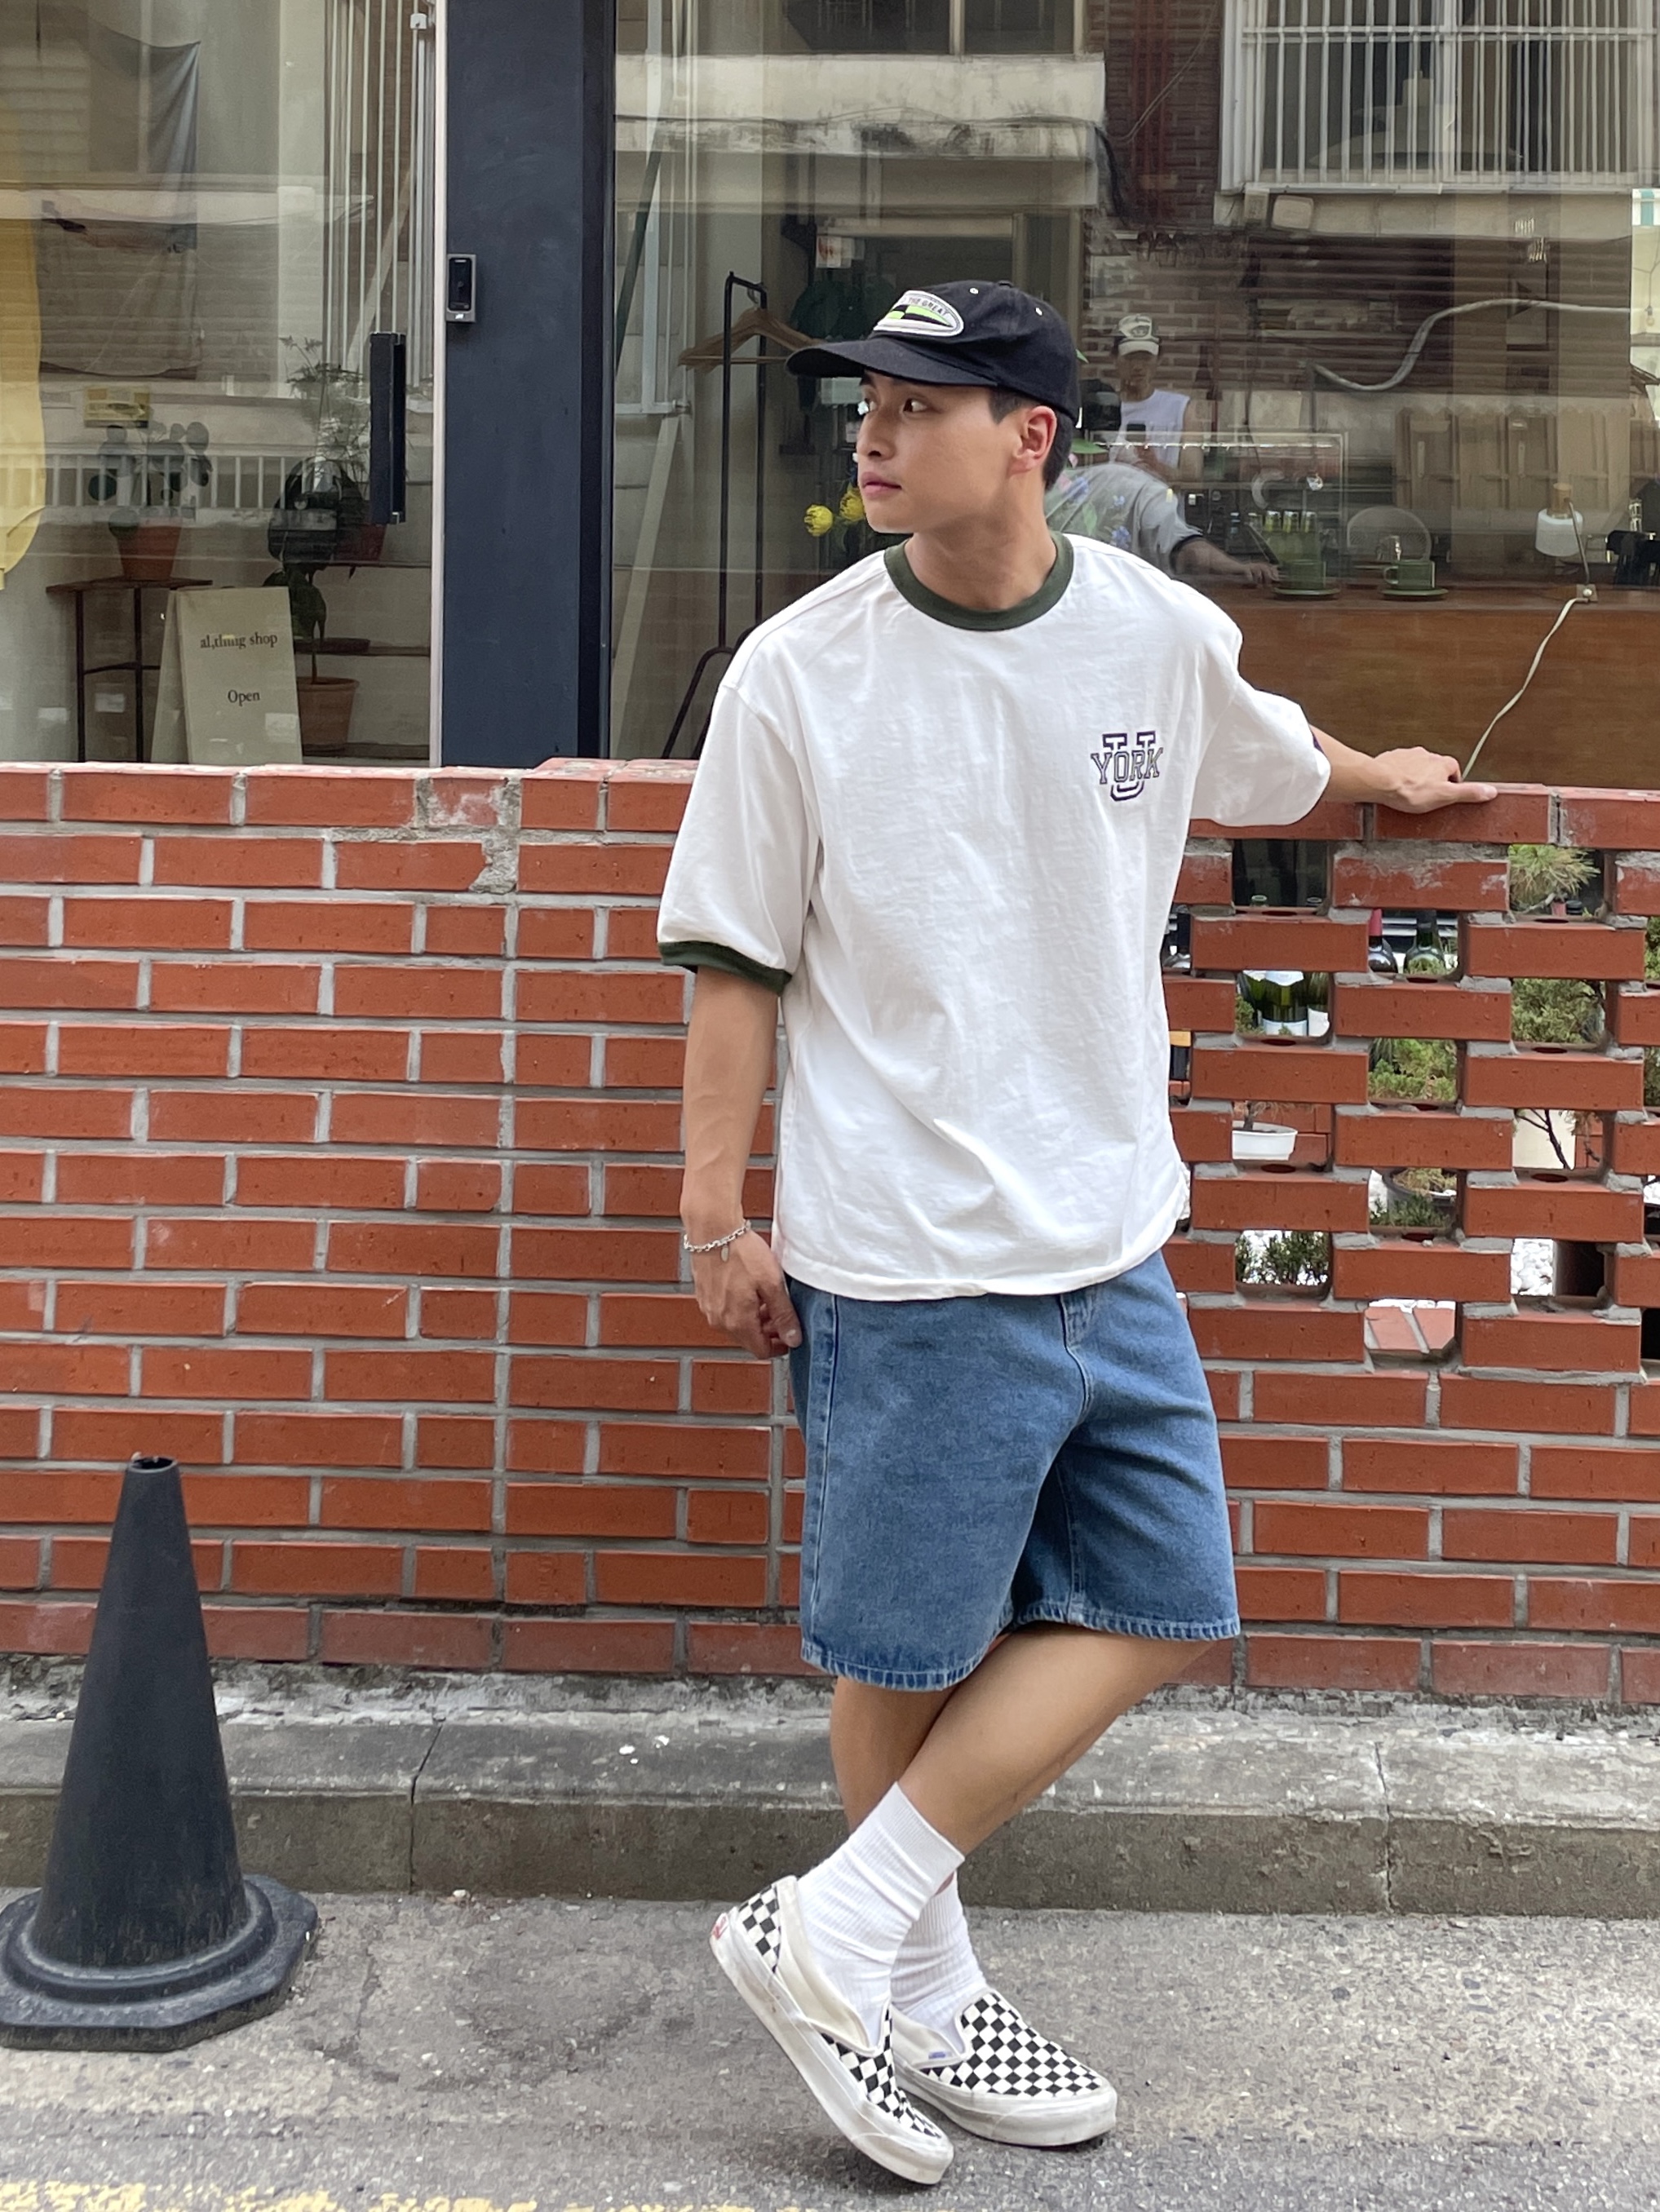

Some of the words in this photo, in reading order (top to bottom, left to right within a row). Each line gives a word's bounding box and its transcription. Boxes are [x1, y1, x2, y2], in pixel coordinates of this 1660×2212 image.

[922, 299, 948, 316] GREAT
[250, 631, 278, 648] shop
[228, 690, 260, 706] Open
[1091, 747, 1163, 785] YORK
